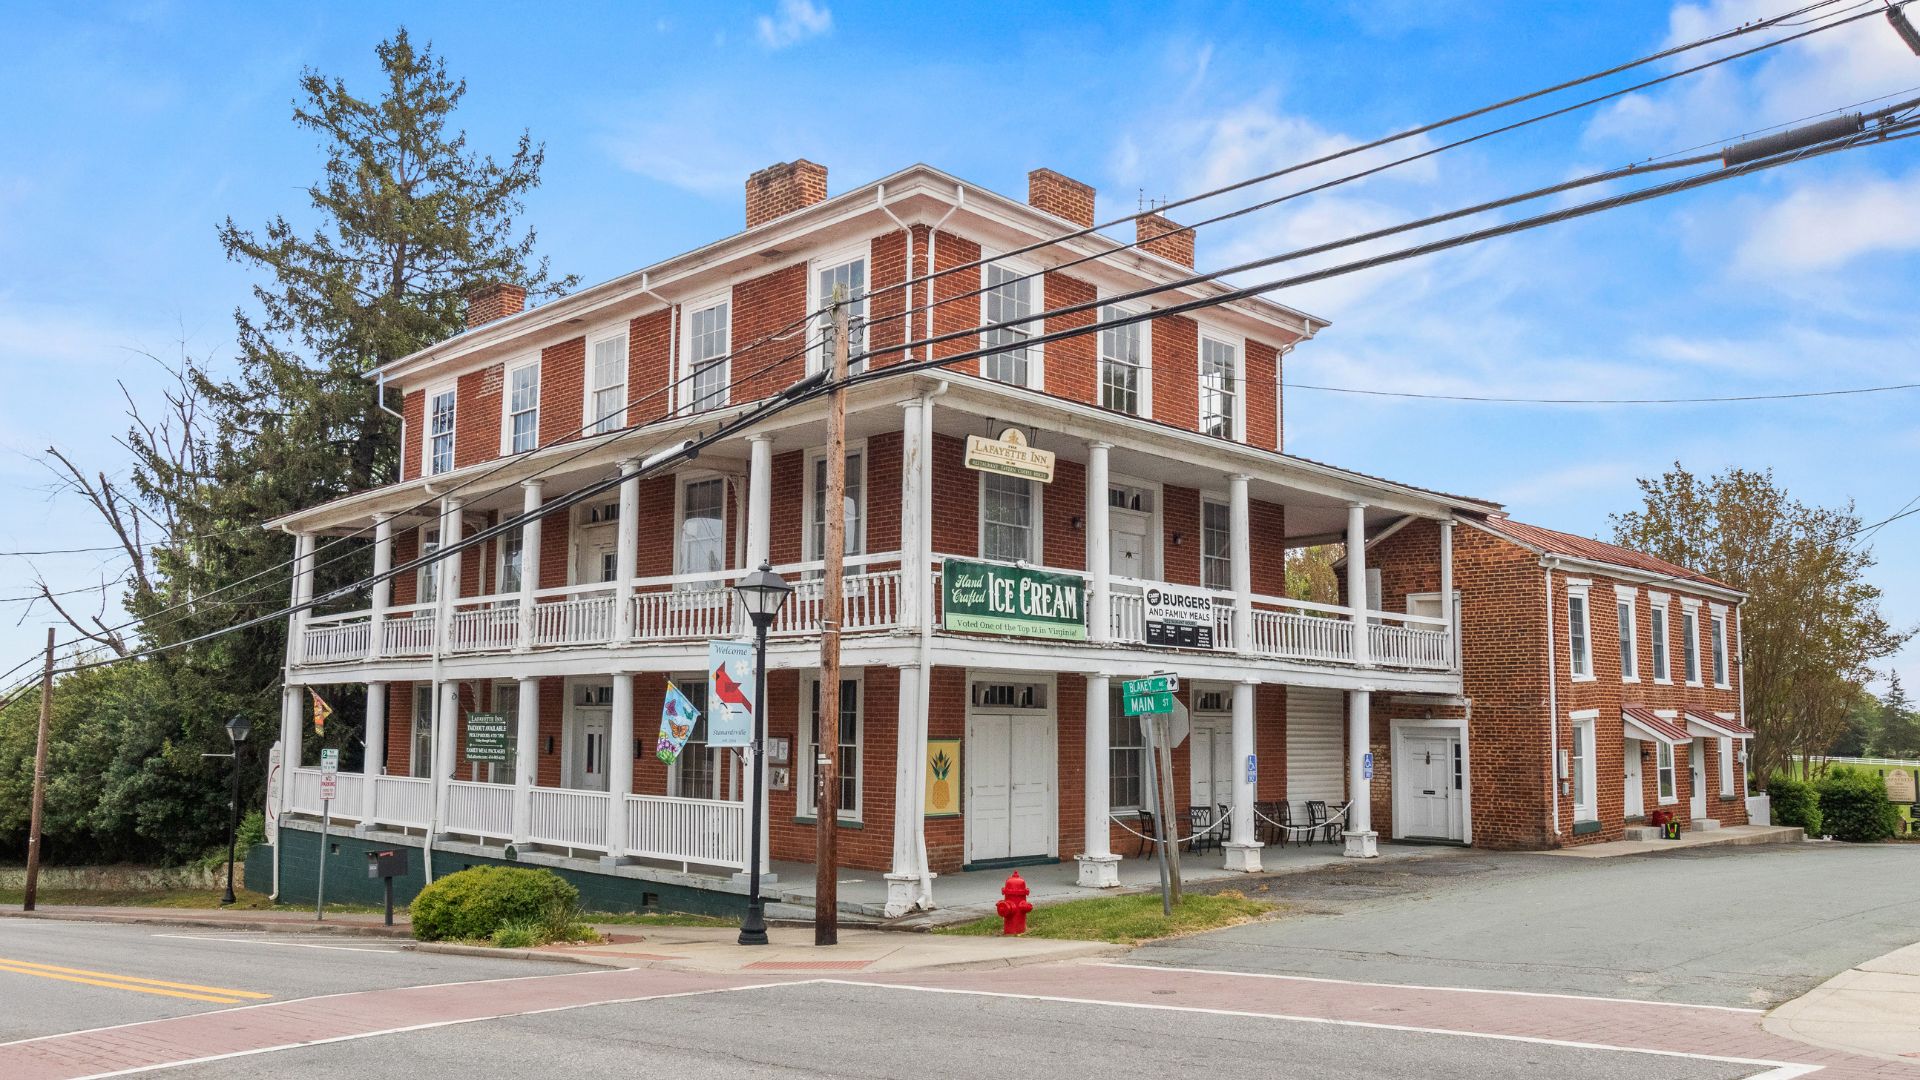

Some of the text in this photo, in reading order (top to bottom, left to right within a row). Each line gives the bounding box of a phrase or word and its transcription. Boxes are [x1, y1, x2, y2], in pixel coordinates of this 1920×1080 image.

[975, 440, 1048, 464] LAFAYETTE INN
[955, 574, 985, 588] Hand
[952, 588, 986, 607] Crafted
[987, 572, 1078, 619] ICE CREAM
[1163, 593, 1211, 610] BURGERS
[1149, 608, 1210, 622] AND FAMILY MEALS
[957, 620, 978, 628] Voted
[980, 621, 994, 630] One
[995, 622, 1002, 630] of
[1004, 623, 1015, 631] the
[1018, 625, 1030, 634] Top
[1039, 626, 1047, 634] in
[1049, 627, 1077, 637] Virginia!
[715, 644, 748, 656] Welcome
[1129, 680, 1152, 693] BLAKEY
[1131, 696, 1169, 712] MAIN ST
